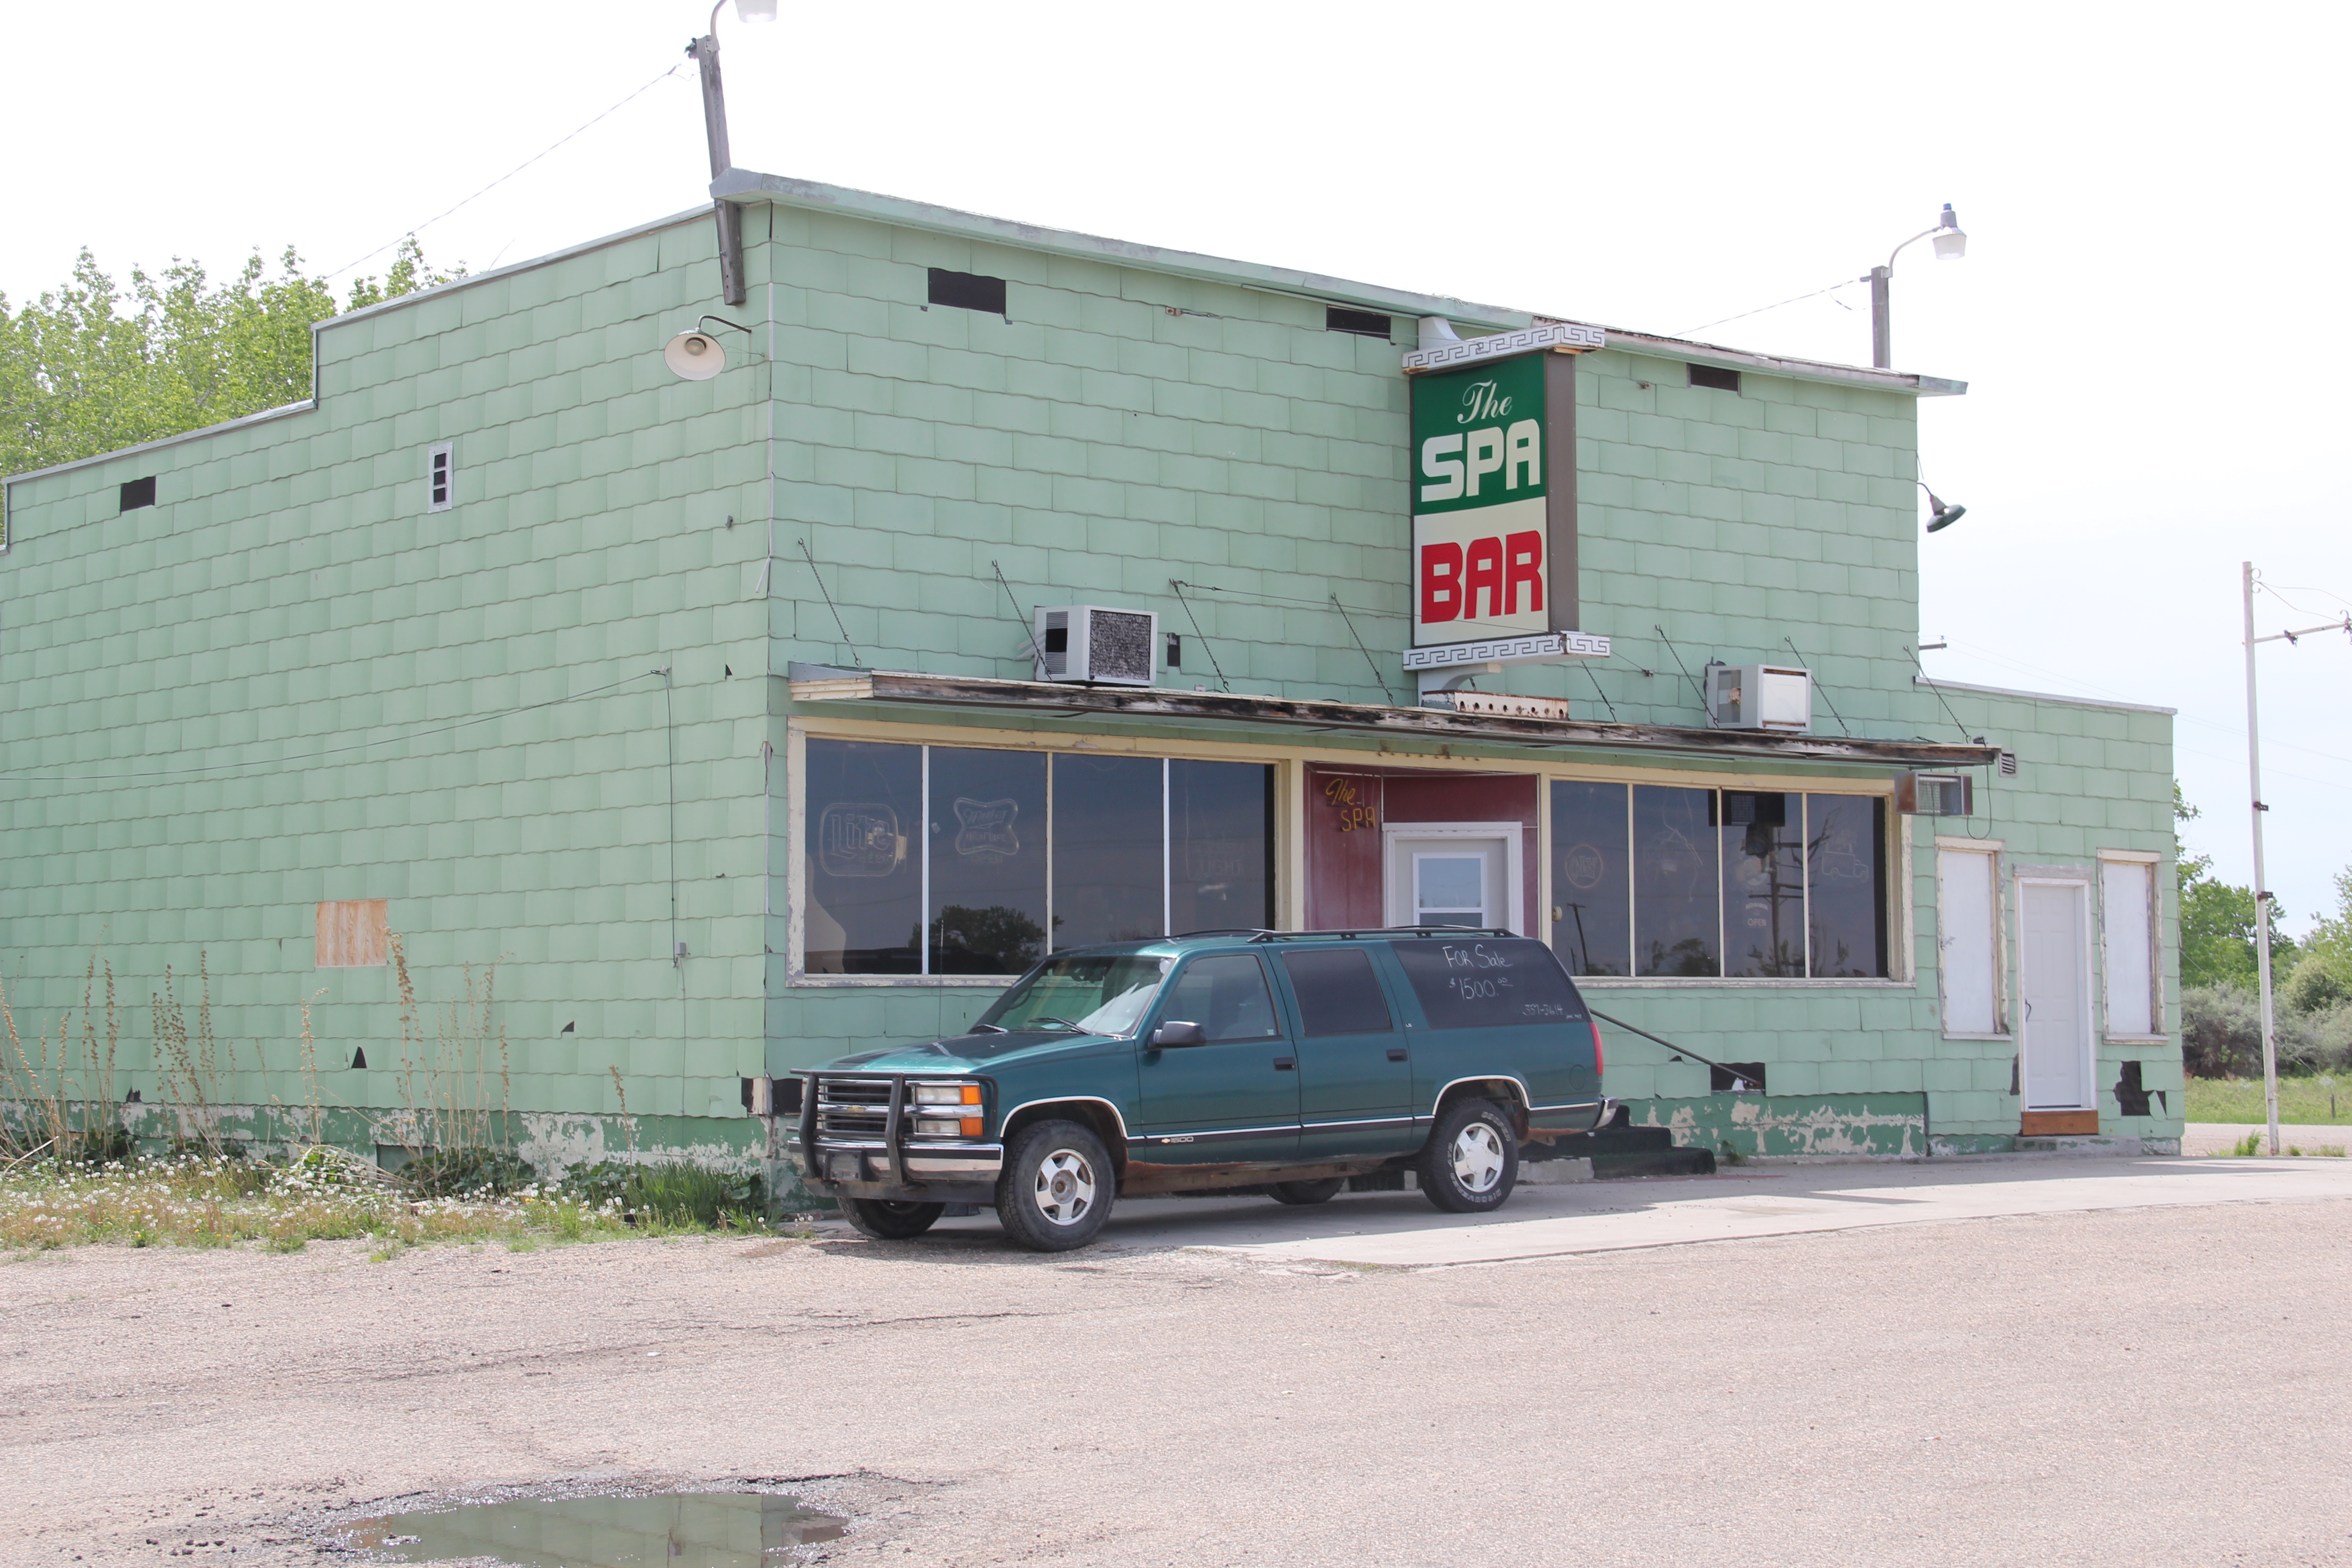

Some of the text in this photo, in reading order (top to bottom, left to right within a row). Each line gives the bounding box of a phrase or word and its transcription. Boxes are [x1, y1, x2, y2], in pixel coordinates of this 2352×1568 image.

[1457, 379, 1512, 424] The
[1421, 418, 1541, 502] SPA
[1421, 529, 1543, 624] BAR
[1325, 778, 1356, 805] The
[1341, 807, 1376, 832] SPA
[830, 813, 891, 859] Lite
[1568, 856, 1598, 880] OLY
[1747, 918, 1767, 926] OPEN
[1442, 944, 1514, 969] FOR Sale
